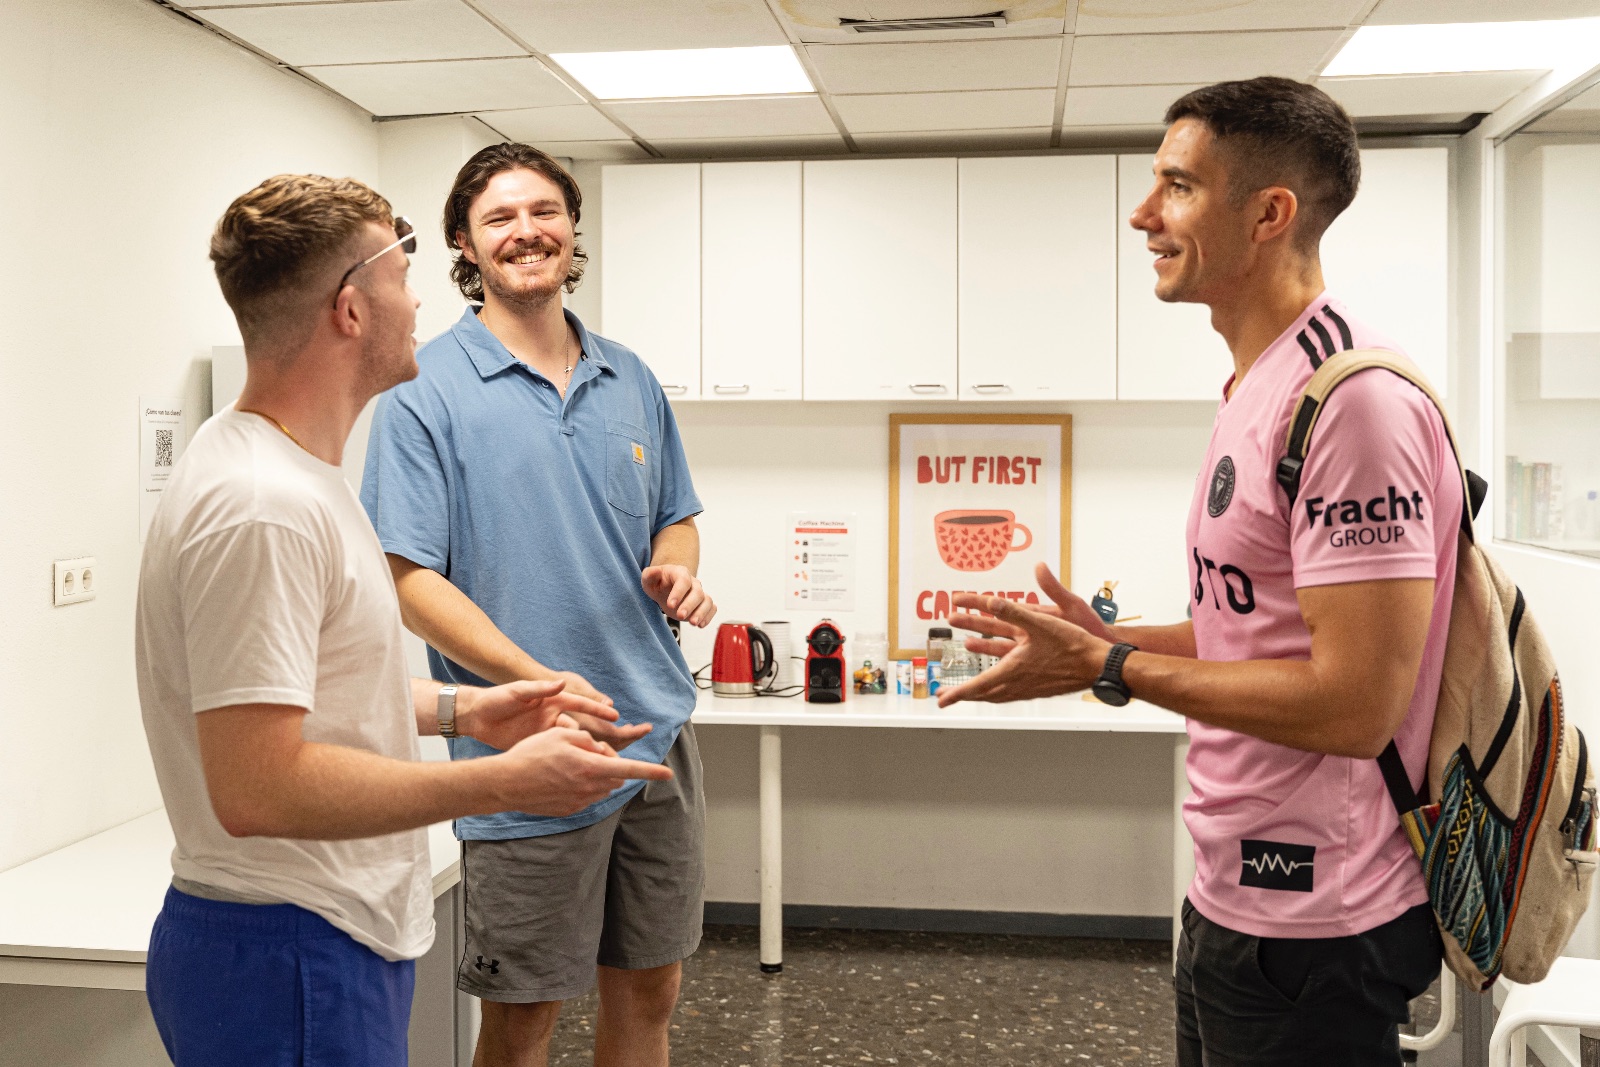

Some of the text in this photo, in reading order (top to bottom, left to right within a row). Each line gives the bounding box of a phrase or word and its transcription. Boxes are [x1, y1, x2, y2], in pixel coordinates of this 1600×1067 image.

[917, 455, 1042, 485] BUT FIRST
[1305, 486, 1424, 529] Fracht
[1330, 525, 1405, 548] GROUP
